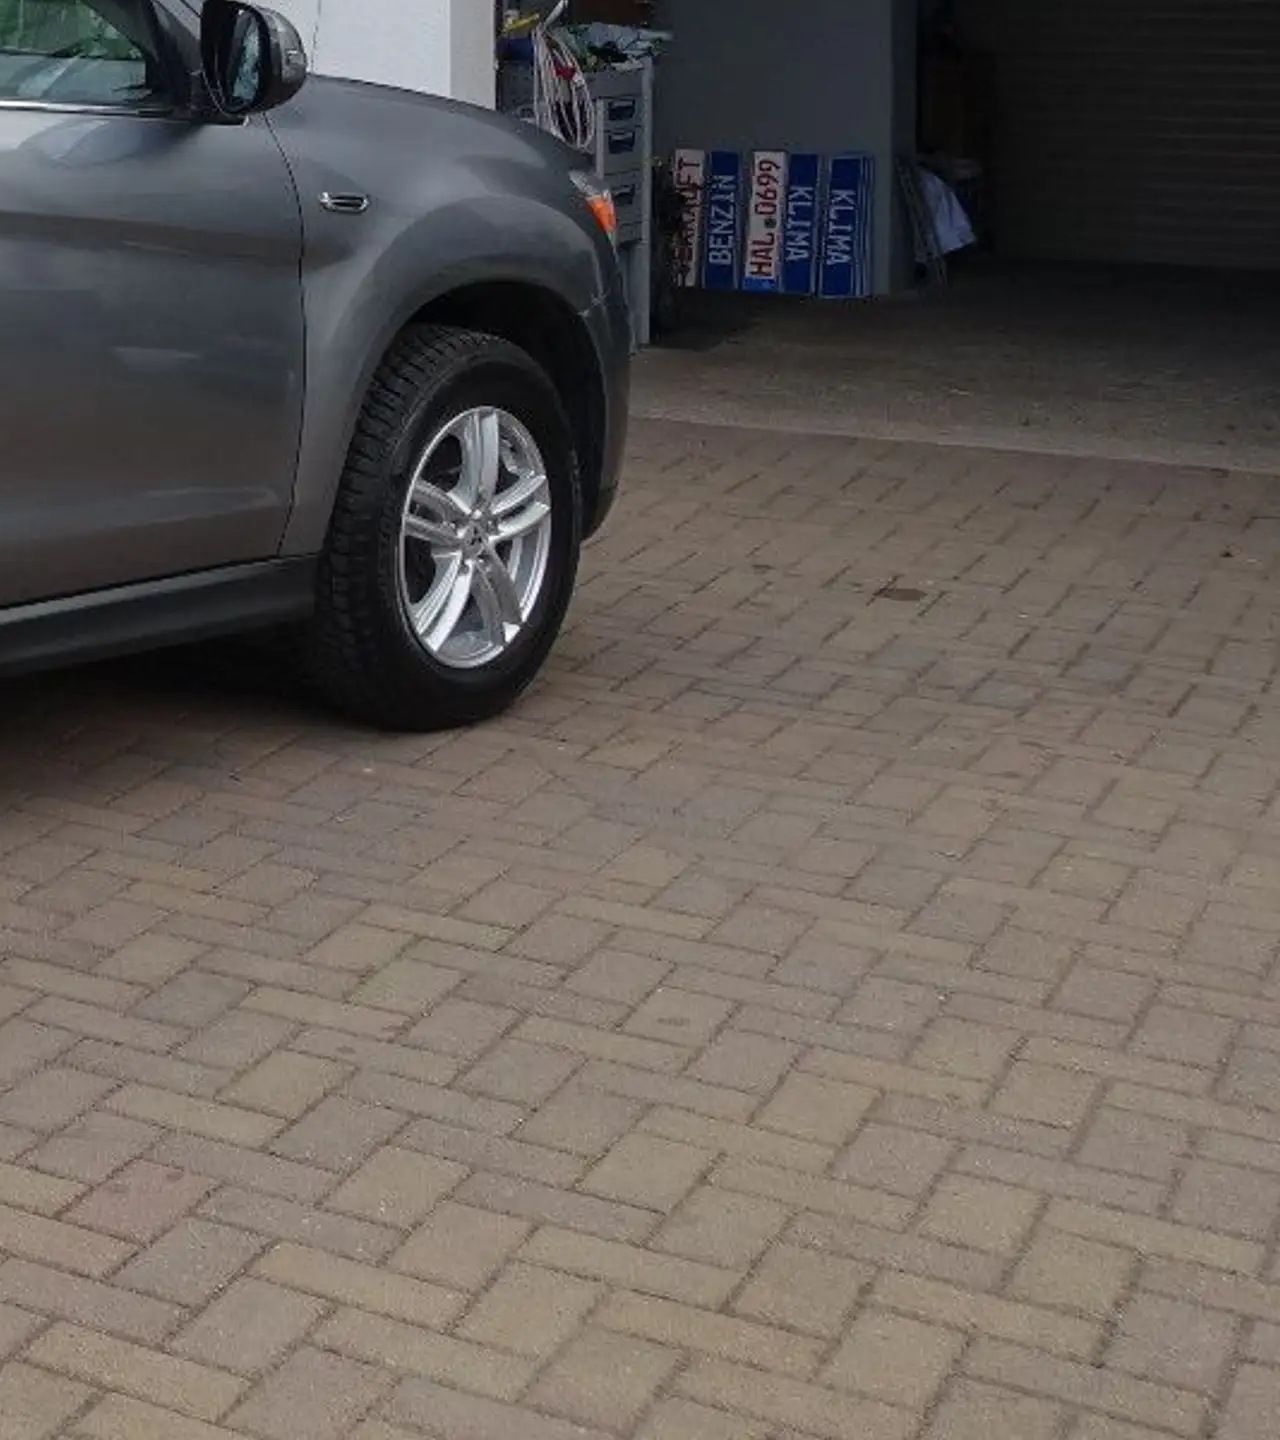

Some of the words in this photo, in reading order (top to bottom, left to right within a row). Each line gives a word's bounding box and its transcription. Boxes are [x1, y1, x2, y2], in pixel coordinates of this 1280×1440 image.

[708, 174, 737, 266] BENZIN
[753, 160, 781, 217] 0699
[785, 184, 815, 262] KLIMA
[825, 188, 857, 266] KLIMA
[749, 234, 775, 277] HAL
